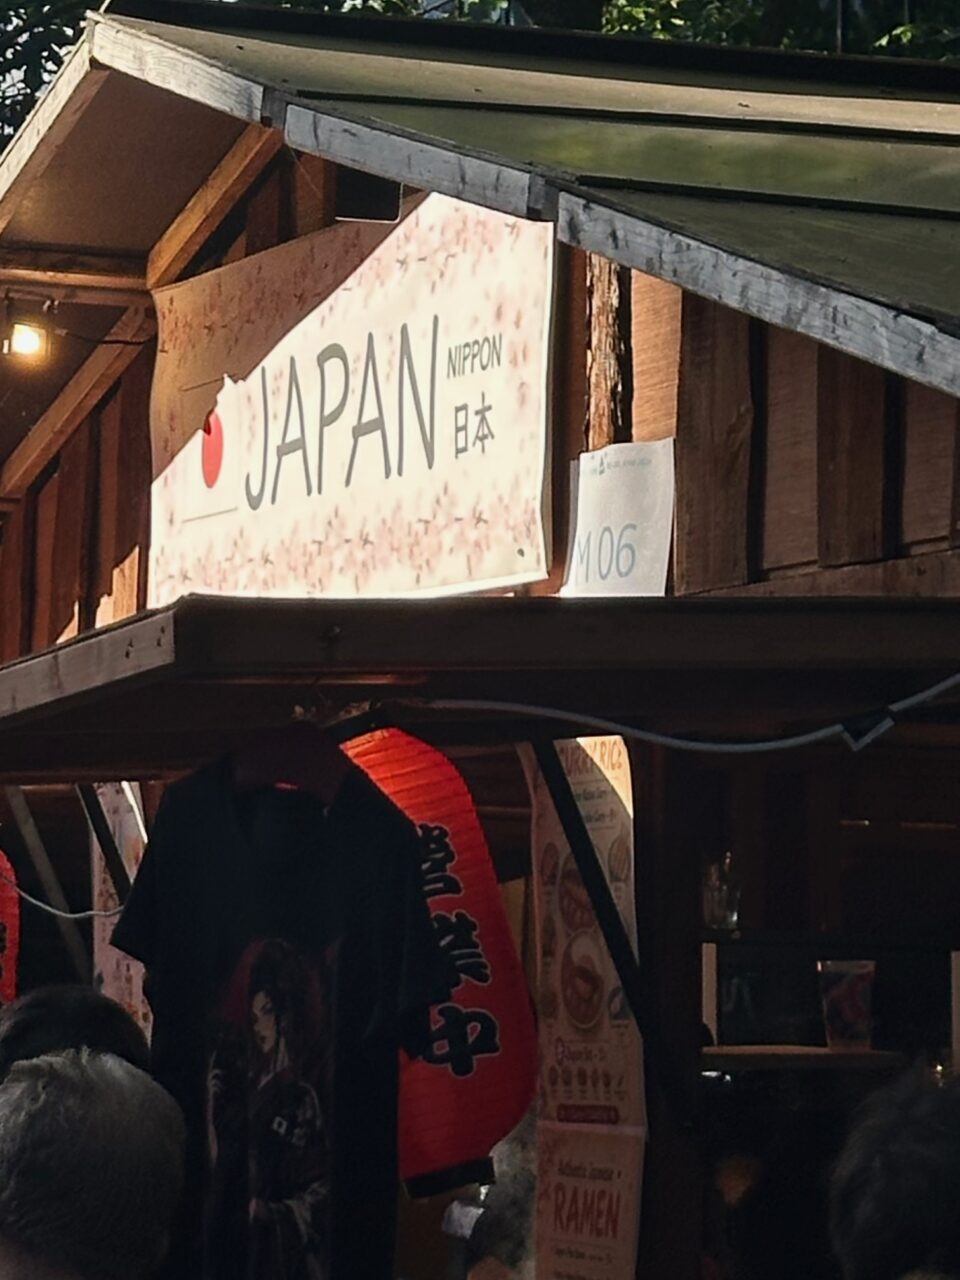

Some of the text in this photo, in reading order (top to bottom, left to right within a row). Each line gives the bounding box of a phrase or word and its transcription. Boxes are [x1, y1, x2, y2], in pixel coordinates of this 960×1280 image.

[447, 333, 502, 379] NIPPON
[245, 314, 439, 511] JAPAN
[455, 391, 495, 459] 日本
[553, 1181, 622, 1239] RAMEN
